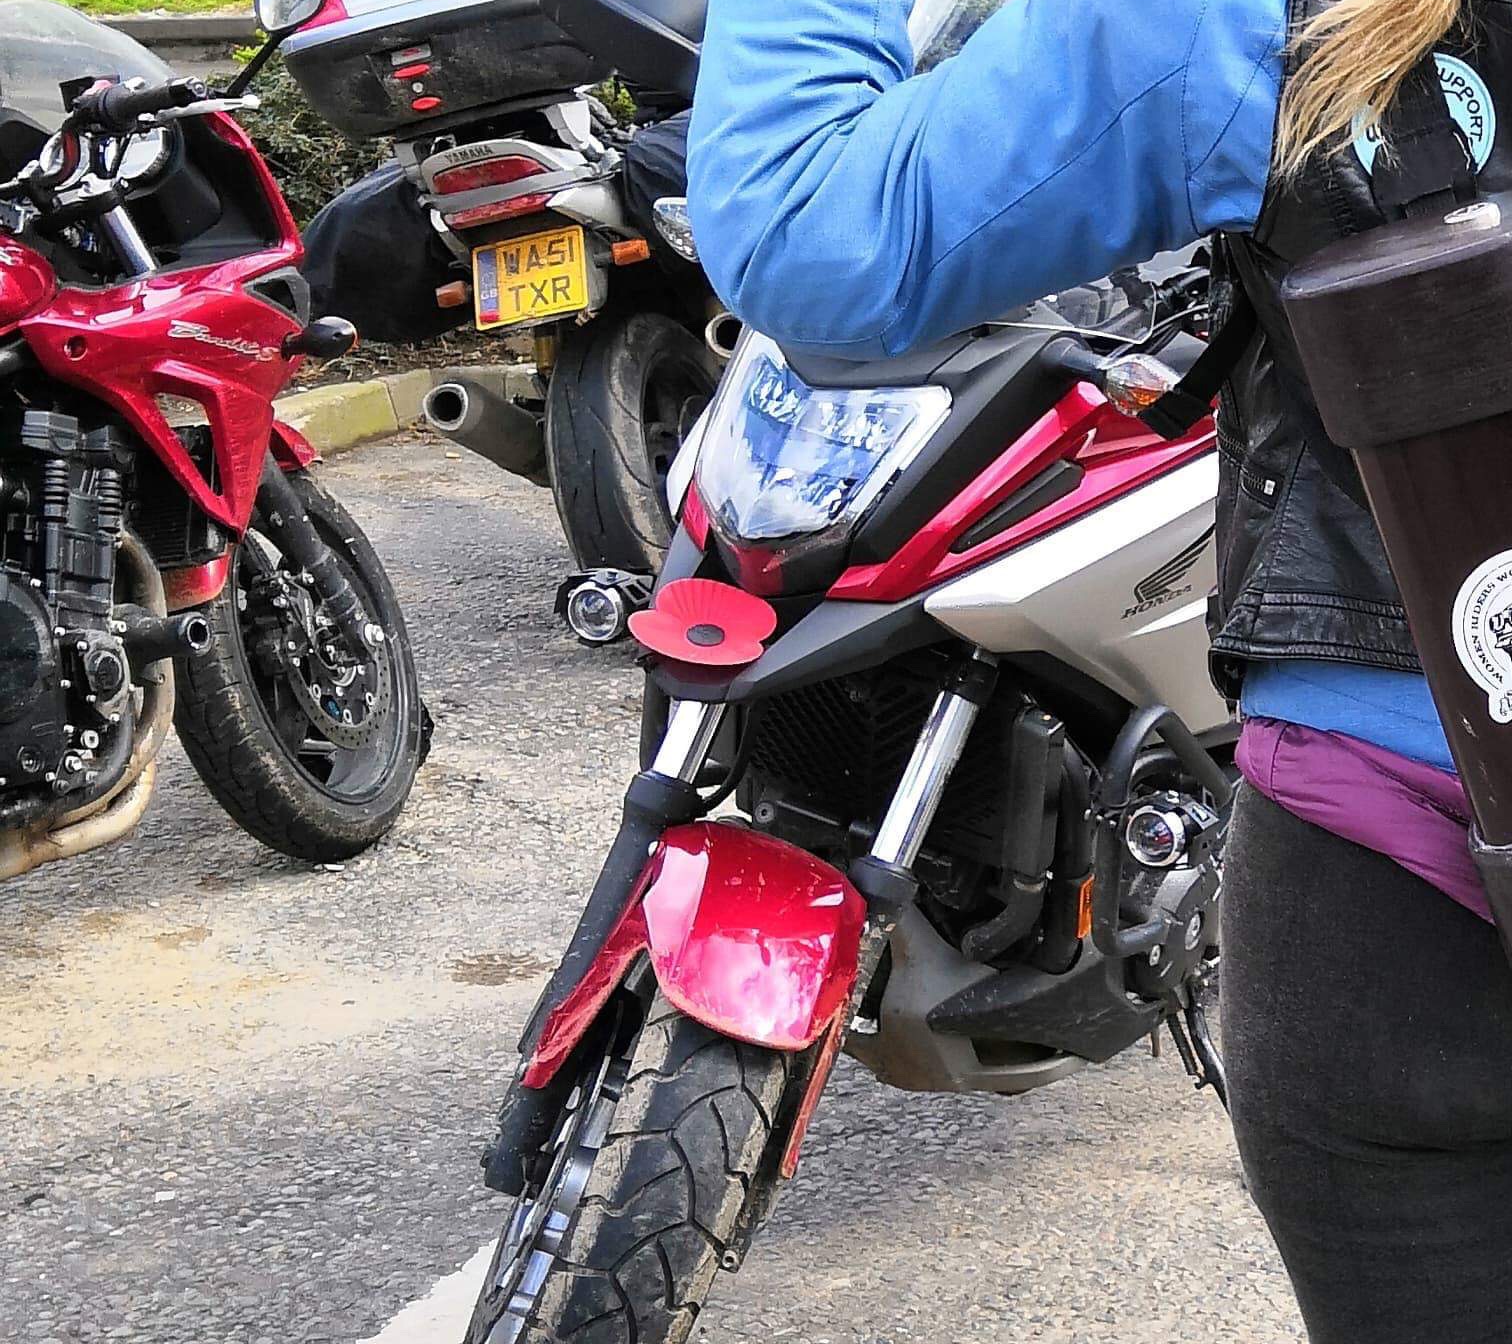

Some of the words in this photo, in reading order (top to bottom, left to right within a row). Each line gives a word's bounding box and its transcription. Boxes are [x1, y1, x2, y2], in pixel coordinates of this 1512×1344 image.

[1440, 67, 1484, 143] UPPORT
[444, 144, 494, 164] YAMAHA
[480, 290, 498, 301] GB
[508, 275, 572, 312] TXR
[1120, 584, 1192, 620] HONDA
[1471, 582, 1496, 630] RIDERS
[1471, 635, 1503, 683] WOMEN
